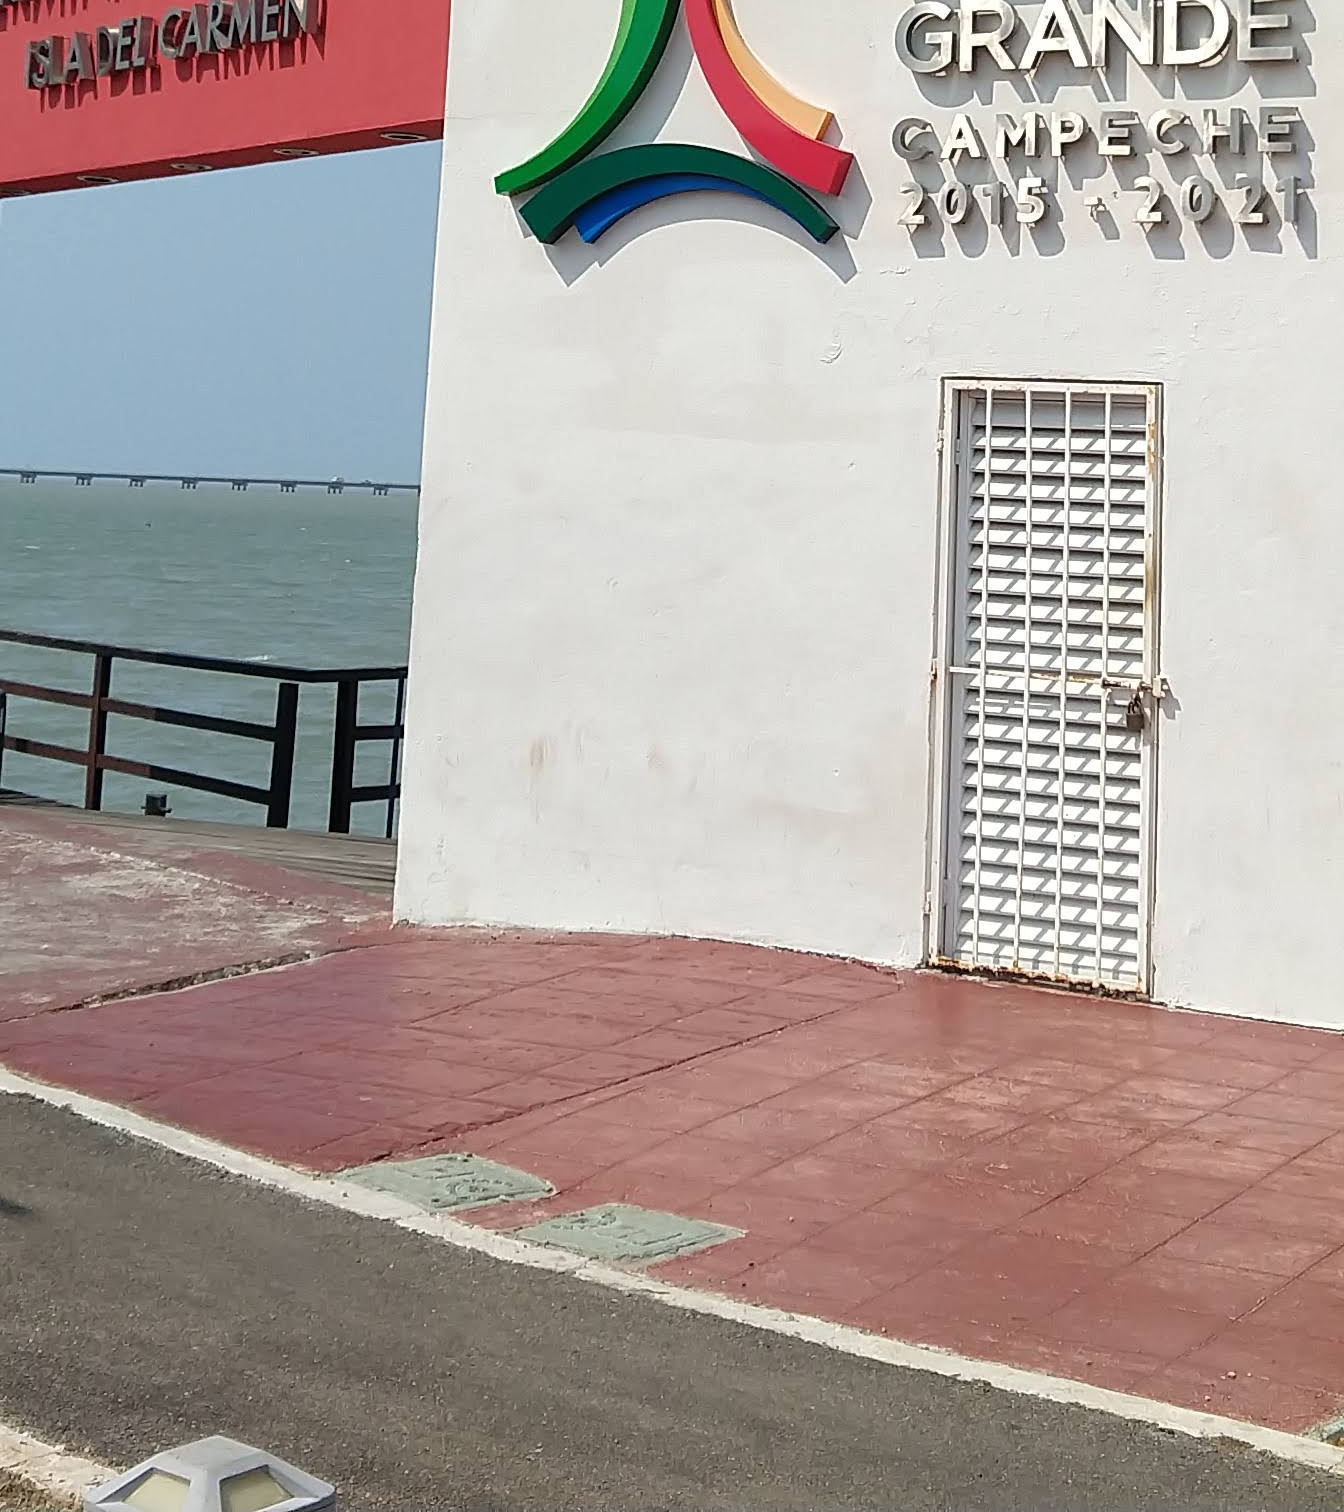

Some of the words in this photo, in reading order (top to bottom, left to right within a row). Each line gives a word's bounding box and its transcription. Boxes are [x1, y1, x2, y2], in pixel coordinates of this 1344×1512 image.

[25, 31, 95, 91] ISLA
[96, 14, 159, 78] DEL
[892, 107, 1306, 160] CAMPECHE
[897, 177, 1049, 225] 2015
[1132, 175, 1302, 224] 2021
